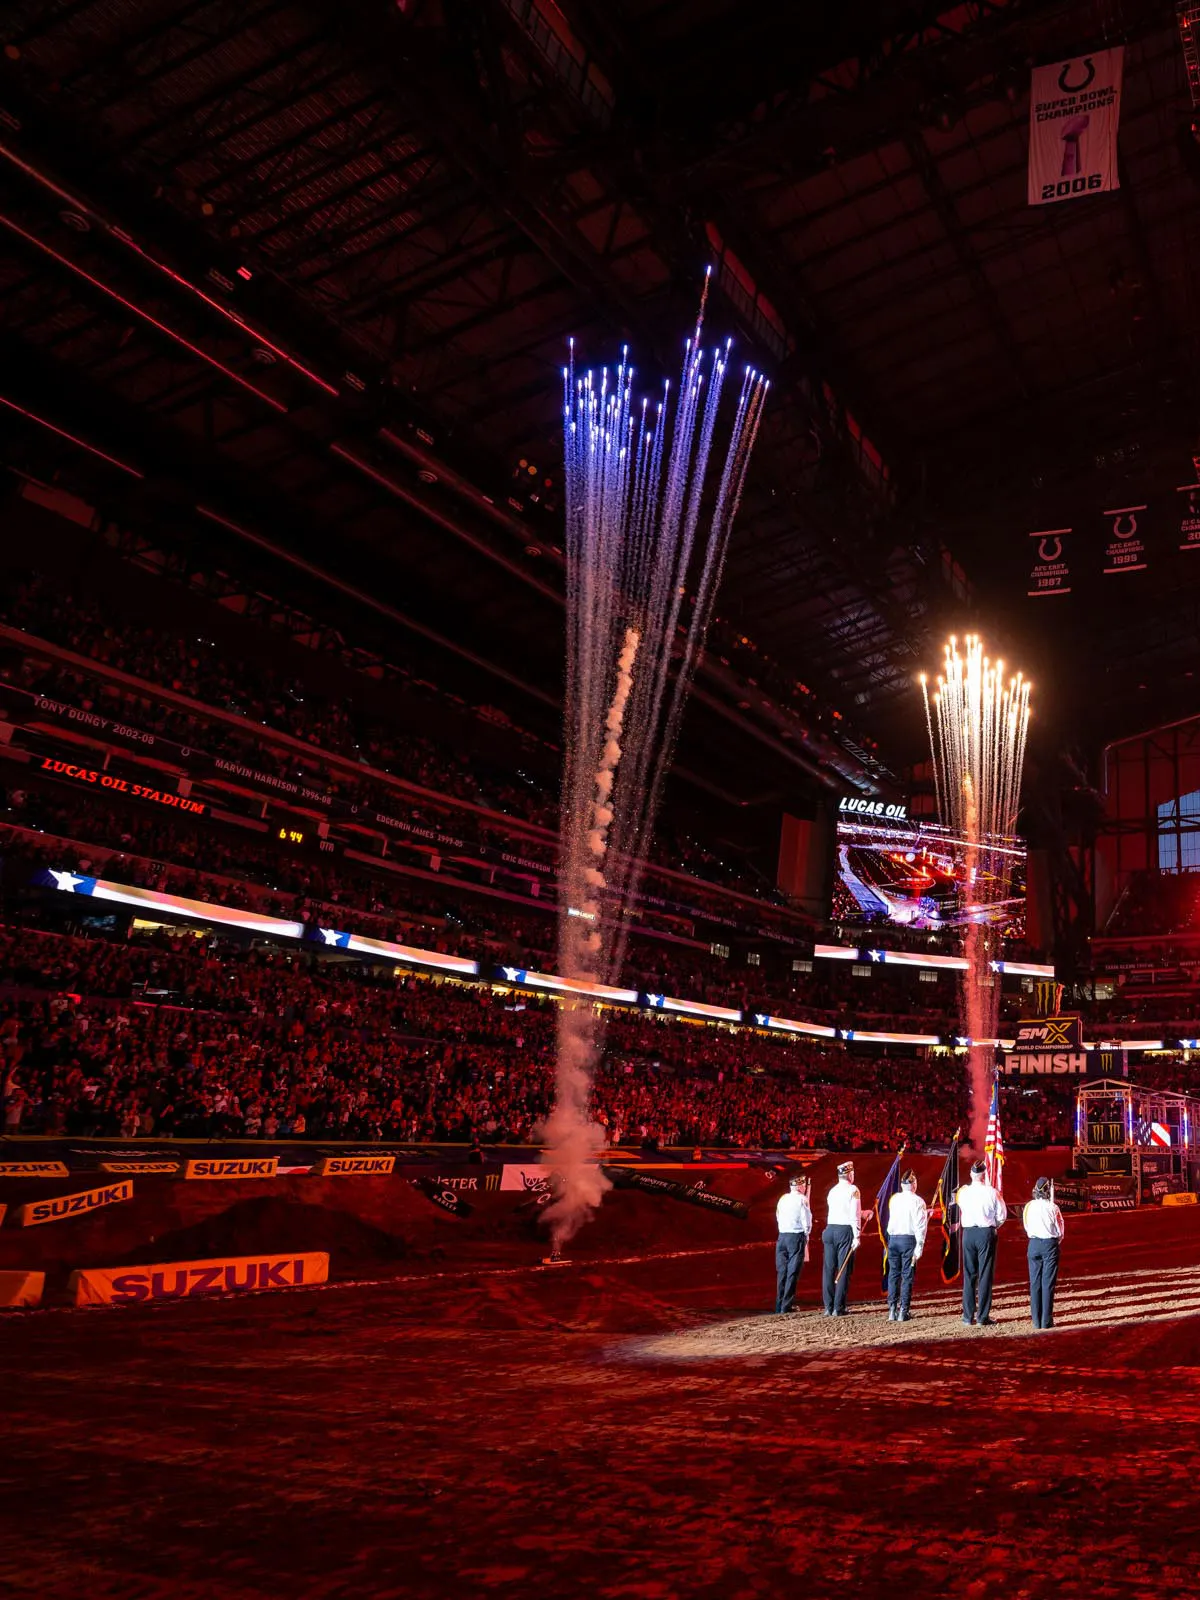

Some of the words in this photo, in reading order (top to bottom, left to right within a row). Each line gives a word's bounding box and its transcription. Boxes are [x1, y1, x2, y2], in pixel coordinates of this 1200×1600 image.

[1035, 95, 1076, 113] SUPER
[1080, 85, 1117, 103] BOWL
[1036, 95, 1115, 123] CHAMPIONS
[1042, 174, 1102, 200] 2006
[1105, 545, 1145, 556] CHAMPIONS
[1112, 553, 1138, 565] 1999
[1030, 567, 1069, 578] CHAMPIONS
[1037, 577, 1061, 588] 1987
[33, 696, 67, 716] TONY
[68, 708, 110, 730] DUNGY
[112, 723, 156, 746] 2002-08
[40, 757, 100, 784] LUCAS
[100, 776, 130, 793] OIL
[130, 783, 206, 816] STADIUM
[215, 758, 253, 778] MARVIN
[254, 771, 298, 794] HARRISON
[838, 796, 885, 816] LUCAS
[885, 804, 907, 819] OIL
[376, 813, 411, 833] EDGERRIN
[411, 826, 435, 840] JAMES
[501, 852, 517, 864] ERIC
[1017, 1022, 1073, 1044] SMX
[1004, 1053, 1087, 1075] FINISH
[110, 1163, 178, 1172] SUZUKI
[193, 1161, 273, 1176] SUZUKI
[328, 1160, 391, 1173] SUZUKI
[31, 1184, 129, 1221] SUZUKI
[111, 1260, 305, 1301] SUZUKI
